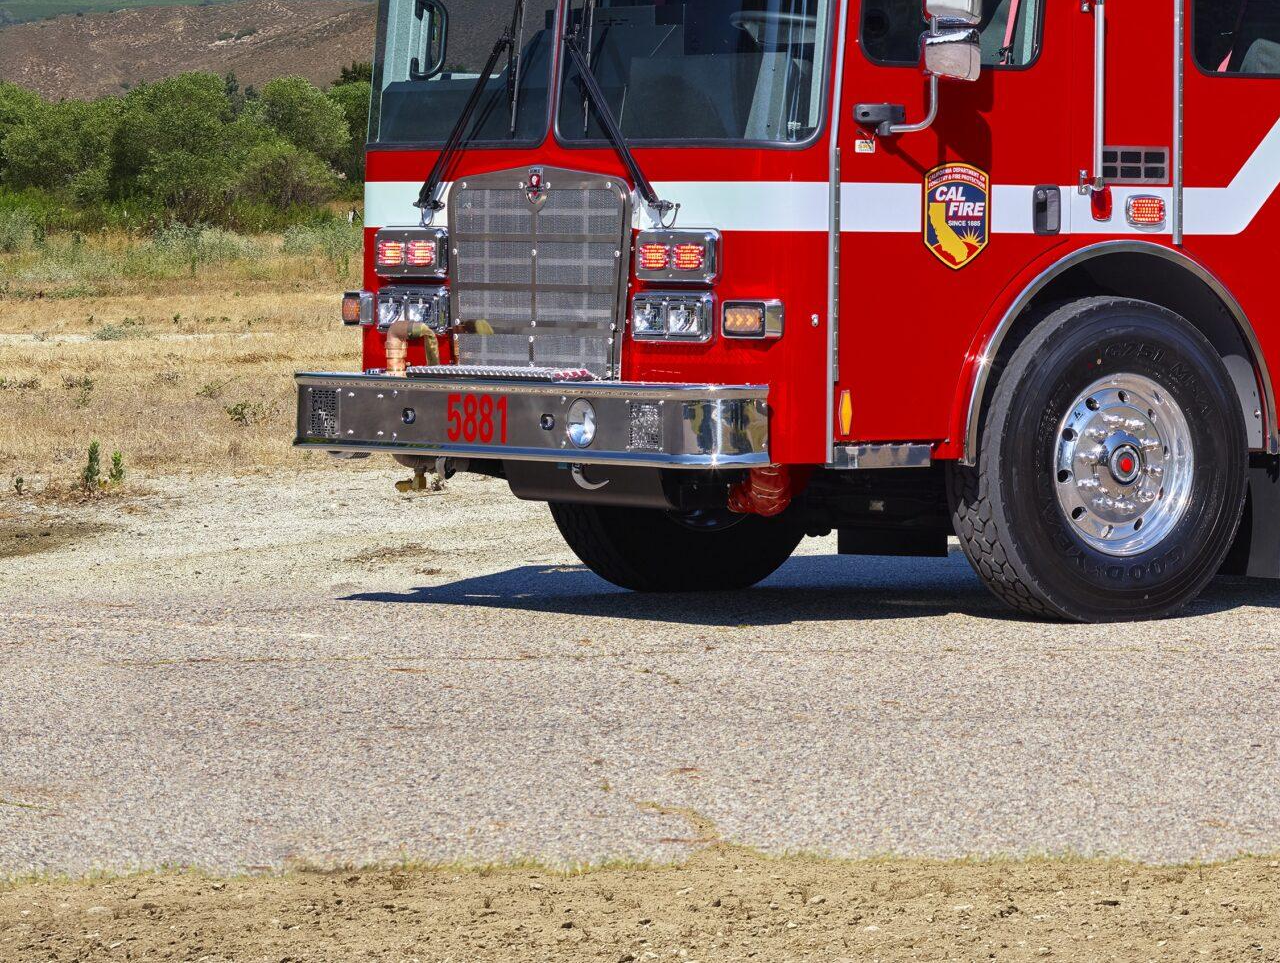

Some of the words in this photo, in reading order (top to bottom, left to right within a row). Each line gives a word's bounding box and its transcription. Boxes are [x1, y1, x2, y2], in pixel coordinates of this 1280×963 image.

[928, 175, 948, 188] FORESTRY
[961, 174, 986, 189] PROTECTION
[929, 168, 952, 181] CALIFORNIA
[952, 167, 980, 179] DEPARTMENT
[935, 186, 966, 201] CAL
[949, 202, 985, 216] FIRE
[447, 392, 508, 445] 5881
